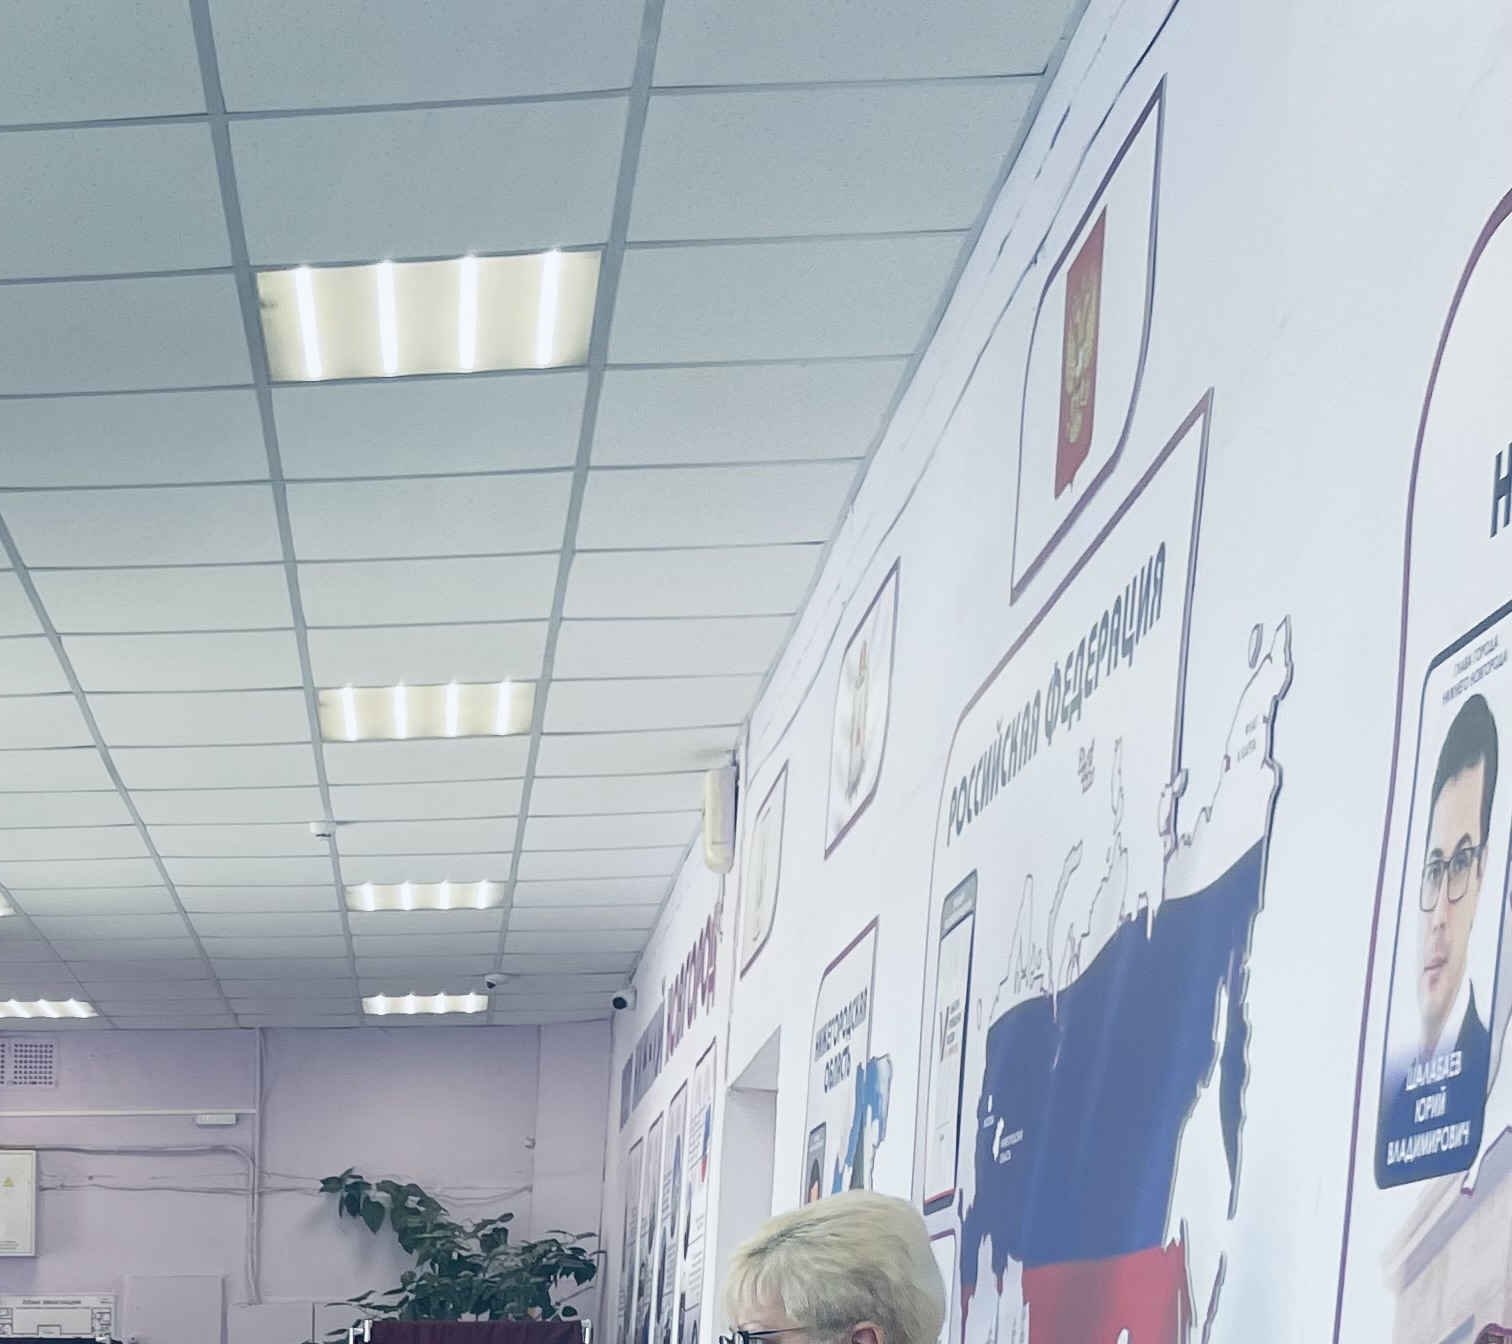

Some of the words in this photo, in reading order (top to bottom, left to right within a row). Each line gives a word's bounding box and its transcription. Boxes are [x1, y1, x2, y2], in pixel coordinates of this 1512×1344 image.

[947, 689, 1041, 848] РОССИЙСКАЯ
[1045, 541, 1166, 747] ФЕДЕРАЦИЯ
[1406, 1050, 1462, 1091] ШАЛАБАЕВ
[1414, 1085, 1447, 1123] ЮРИЙ
[1387, 1120, 1470, 1165] ВЛАДИМИРОВИЧ
